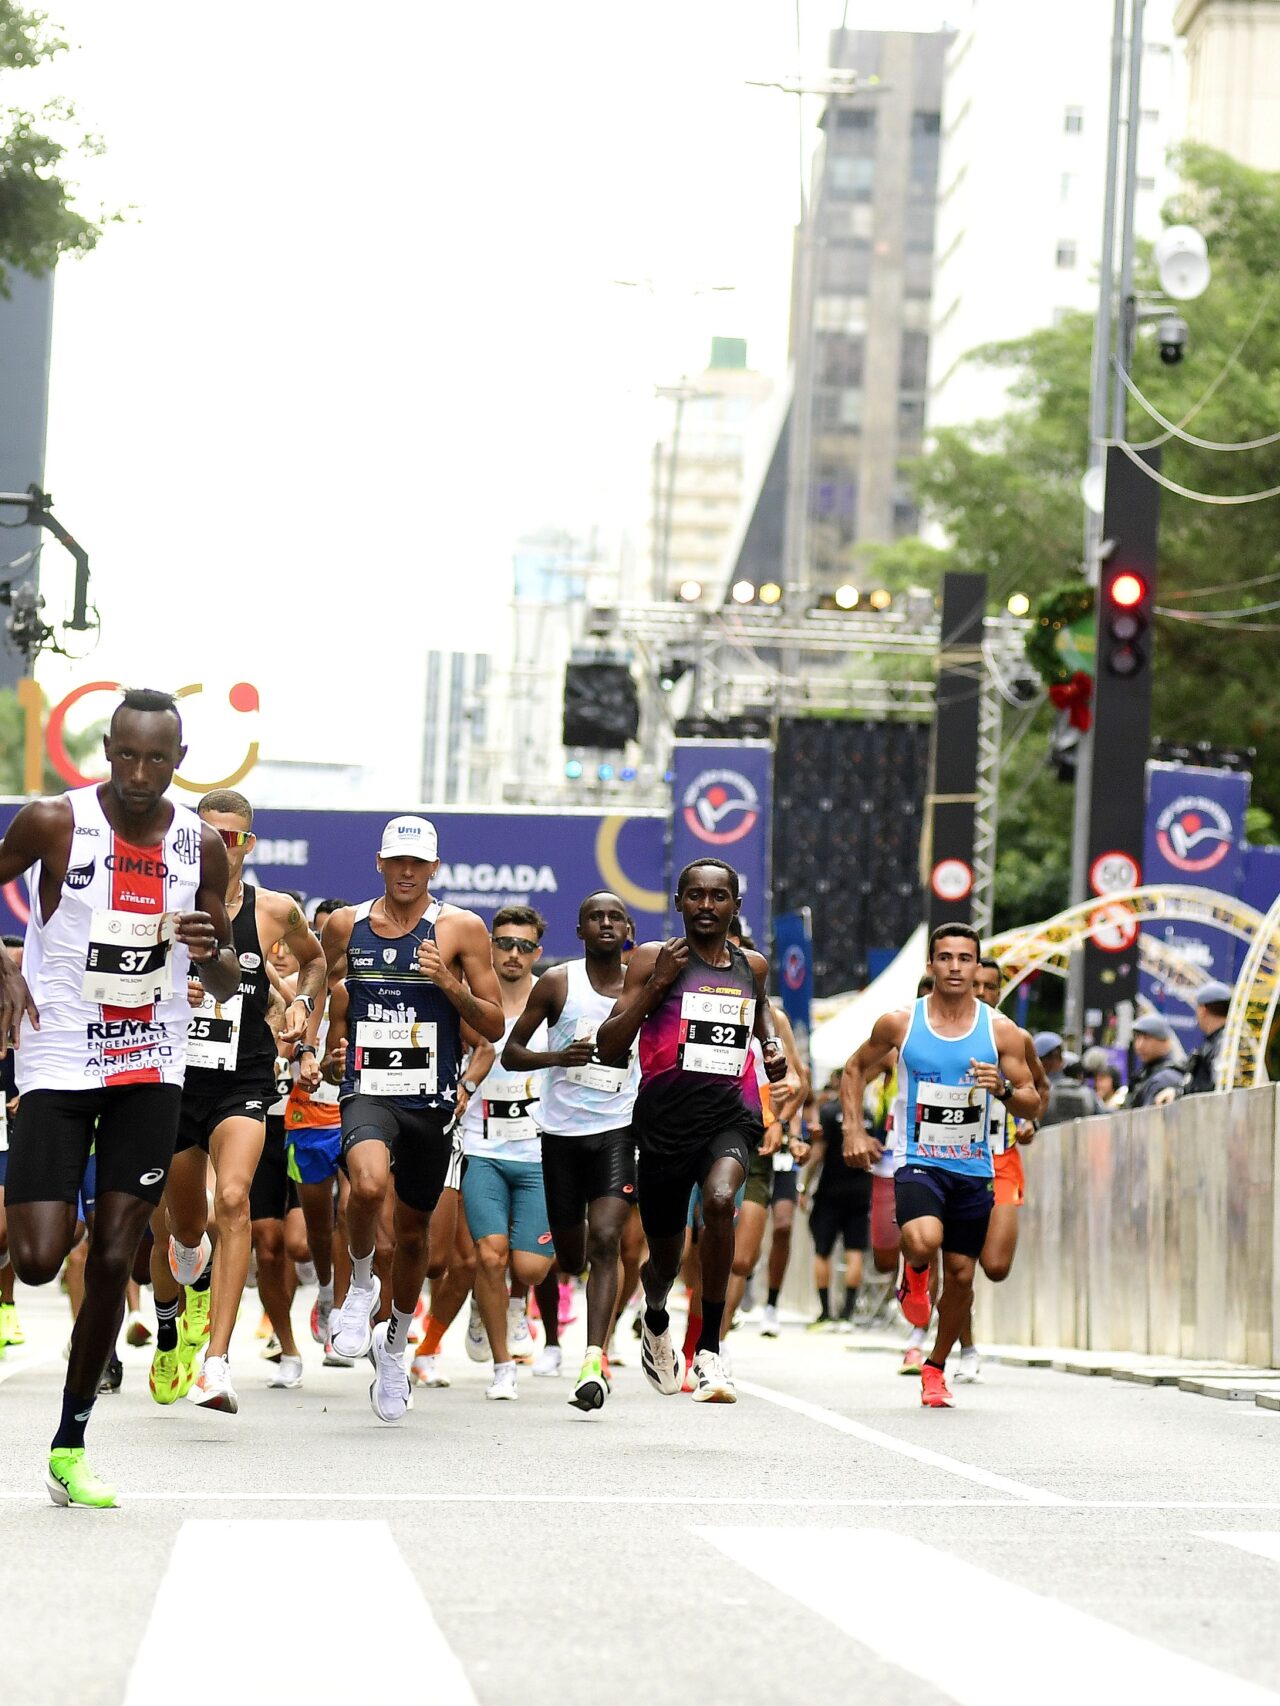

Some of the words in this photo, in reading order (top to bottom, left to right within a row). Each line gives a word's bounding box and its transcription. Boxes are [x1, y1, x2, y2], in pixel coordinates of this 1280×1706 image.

[75, 827, 100, 837] asics
[398, 826, 421, 834] Unit
[104, 854, 169, 879] CIMED
[67, 874, 92, 885] THV
[427, 863, 558, 893] ARGADA
[120, 894, 156, 905] ATHLETA
[118, 950, 152, 972] 37
[187, 1020, 210, 1038] 25
[710, 1025, 736, 1045] 32
[87, 1032, 170, 1049] ENGENHARIA
[86, 1046, 172, 1067] ARISTO
[388, 1050, 403, 1068] 2
[508, 1102, 521, 1118] 6
[941, 1109, 964, 1124] 28
